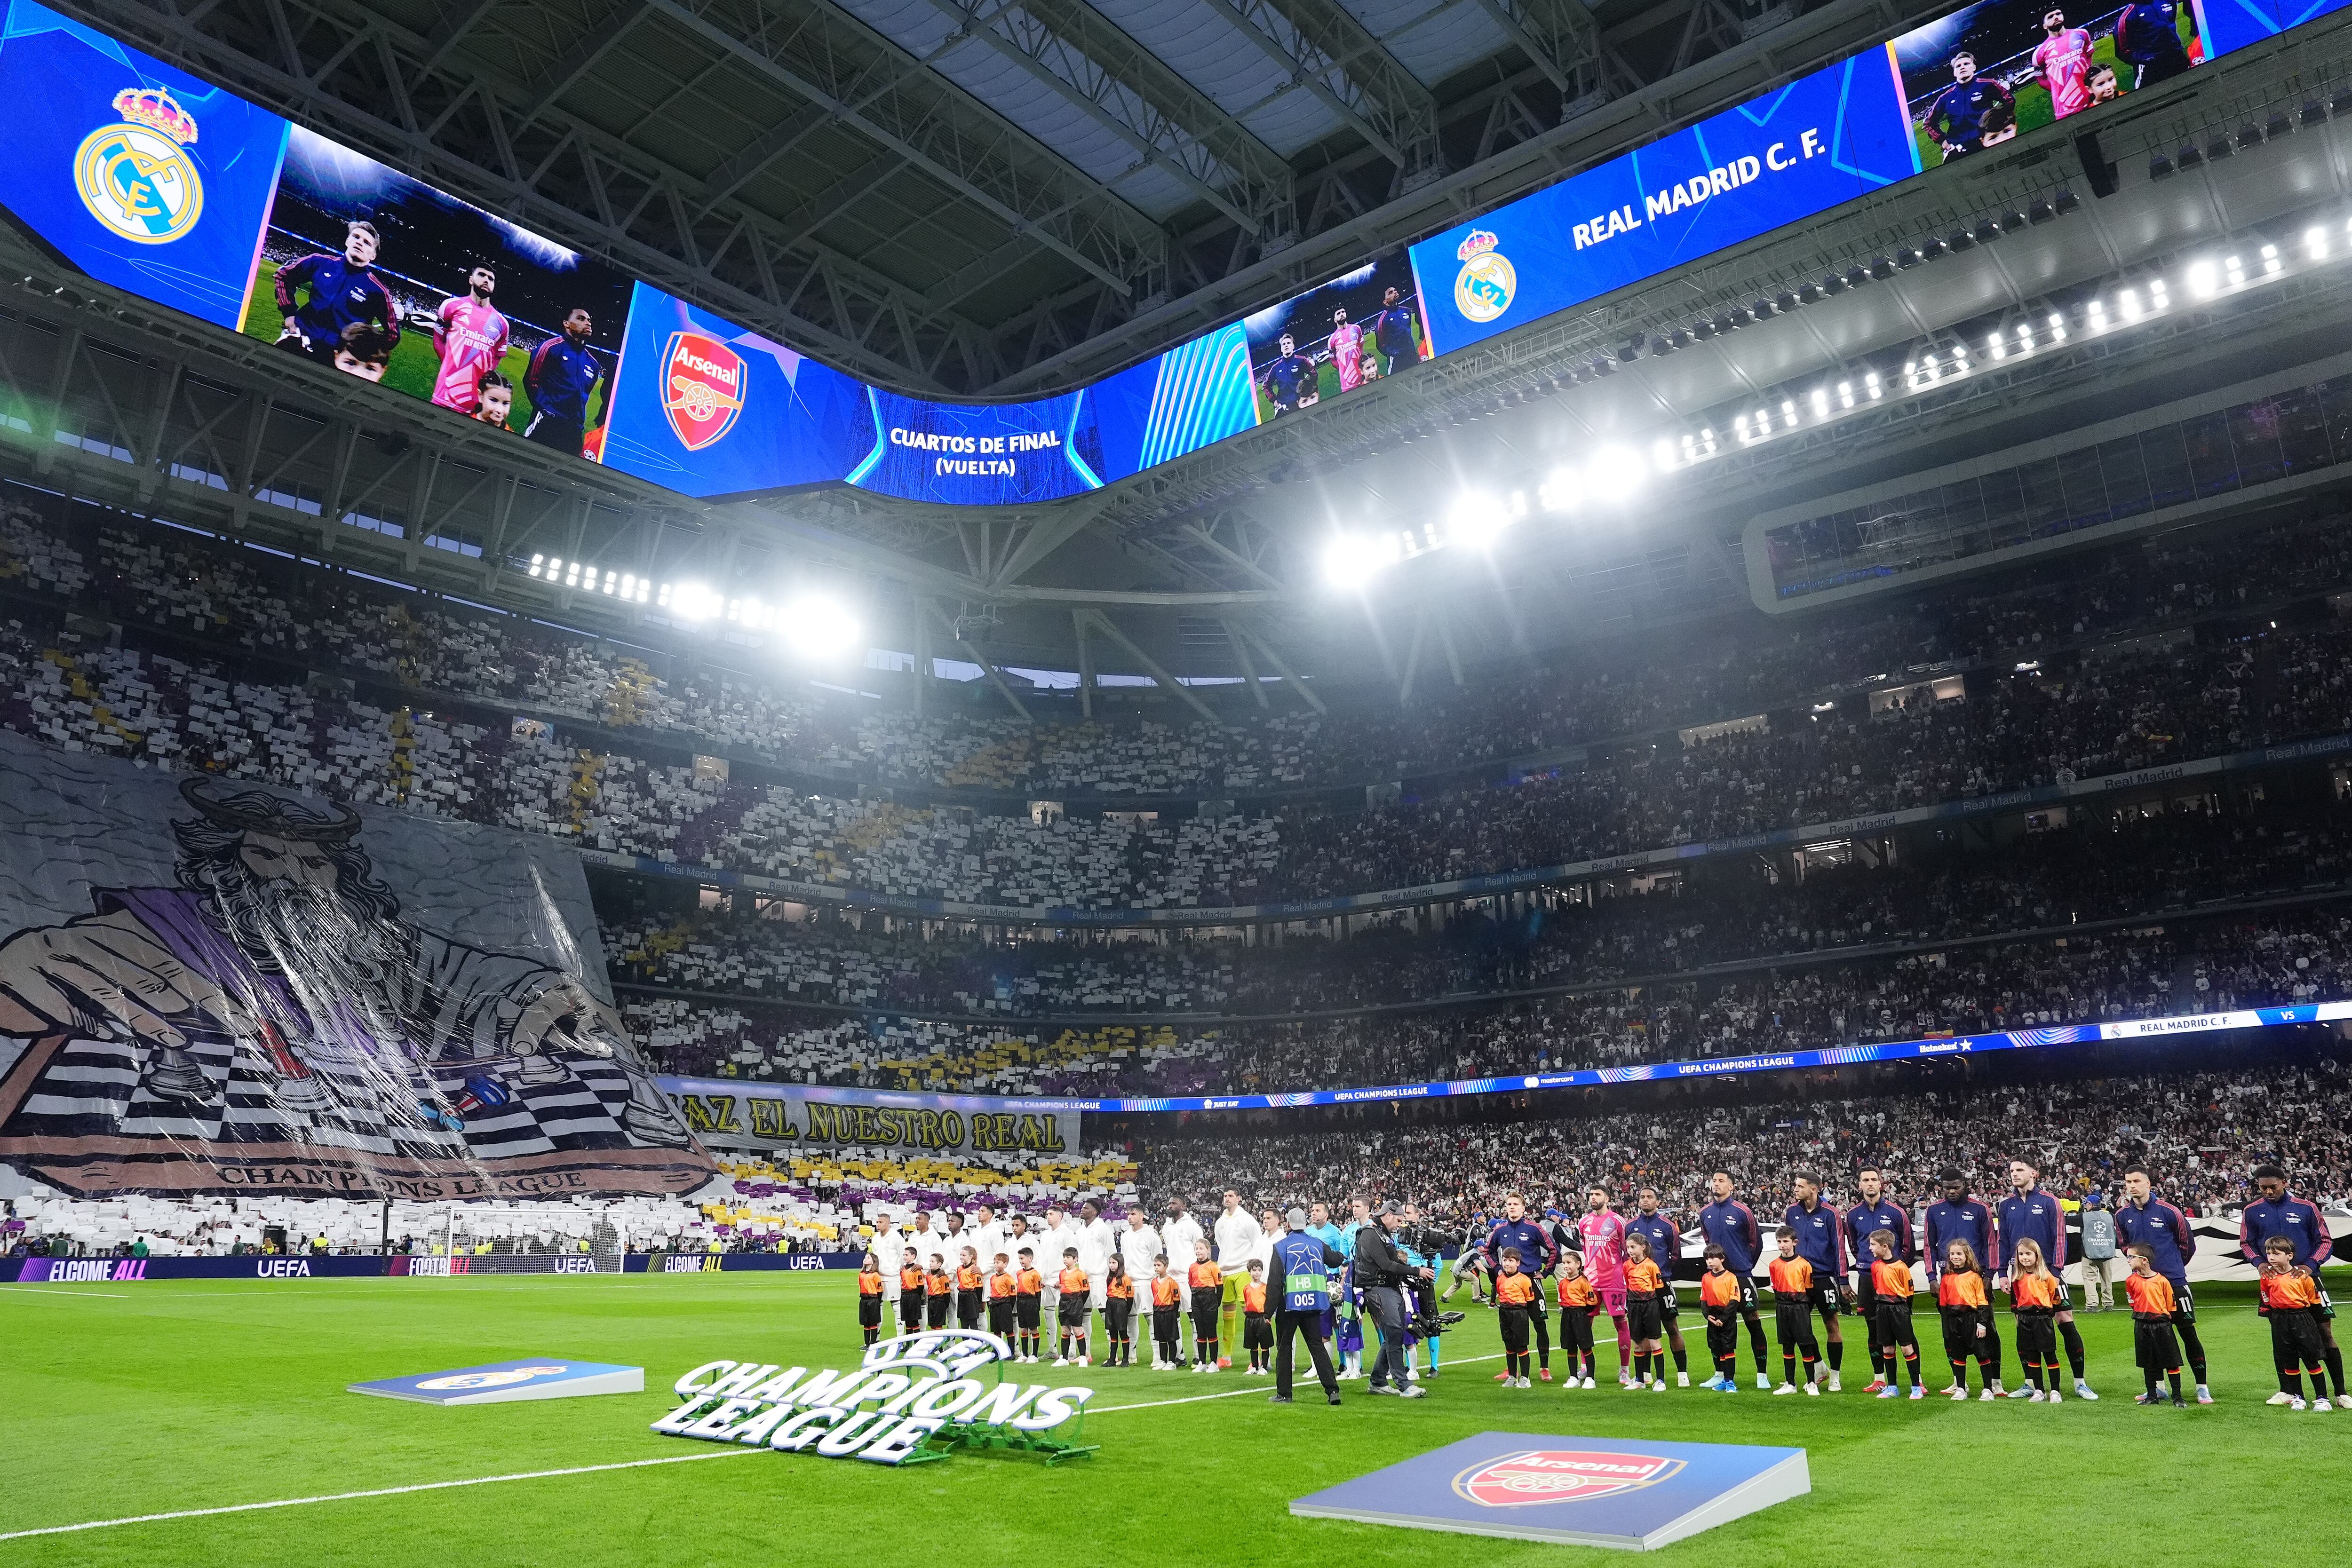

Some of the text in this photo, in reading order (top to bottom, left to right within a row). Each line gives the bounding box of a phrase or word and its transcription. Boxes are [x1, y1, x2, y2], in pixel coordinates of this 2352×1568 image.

[1572, 127, 1825, 250] REAL MADRID C. F.
[460, 326, 496, 347] Emirates
[675, 346, 737, 387] Arsenal
[890, 428, 1060, 454] CUARTOS DE FINAL
[936, 459, 1016, 476] (VUELTA)
[2265, 737, 2350, 760] Real Madrid
[2105, 767, 2183, 789] Real Madrid
[1963, 792, 2031, 811] Real Madrid
[1829, 816, 1896, 834] Real Madrid
[1708, 836, 1766, 852] Real Madrid
[1592, 855, 1649, 871] Real Madrid
[664, 864, 717, 881] Real Madrid
[1485, 872, 1537, 887] Real Madrid
[769, 881, 821, 896] Real Madrid
[1382, 888, 1433, 902] Real Madrid
[869, 895, 917, 908] Real Madrid
[1283, 900, 1332, 912] Real Madrid
[968, 907, 1020, 917] Real Madrid
[1073, 911, 1124, 919] Real Madrid
[1200, 911, 1232, 919] Madrid
[2280, 1011, 2295, 1021] VS
[2140, 1022, 2165, 1032] REAL
[2167, 1018, 2208, 1029] MADRID
[2210, 1017, 2221, 1026] C.
[1919, 1042, 1957, 1053] Heineken
[1679, 1057, 1794, 1074] UEFA CHAMPIONS LEAGUE
[1541, 1075, 1573, 1084] mastercard
[1354, 1089, 1398, 1099] CHAMPIONS
[1399, 1087, 1428, 1096] LEAGUE
[747, 1097, 799, 1139] EL
[804, 1101, 965, 1152] NUESTRO
[971, 1113, 1065, 1152] REAL
[215, 1168, 587, 1198] CHAMPIONS LEAGUE
[112, 1260, 147, 1281] ALL
[257, 1260, 310, 1277] UEFA
[555, 1258, 596, 1273] UEFA
[702, 1256, 723, 1272] ALL
[790, 1256, 825, 1269] UEFA
[1295, 1277, 1311, 1289] HB
[1295, 1293, 1315, 1307] 005
[1611, 1293, 1623, 1306] 22
[1663, 1295, 1676, 1309] 12
[1744, 1288, 1753, 1302] 2
[1824, 1289, 1836, 1304] 15
[1539, 1299, 1546, 1312] 8
[2179, 1296, 2193, 1313] 11
[862, 1336, 994, 1380] UEFA
[673, 1359, 1095, 1431] CHAMPIONS
[650, 1394, 945, 1464] LEAGUE
[1510, 1457, 1655, 1474] Arsenal
